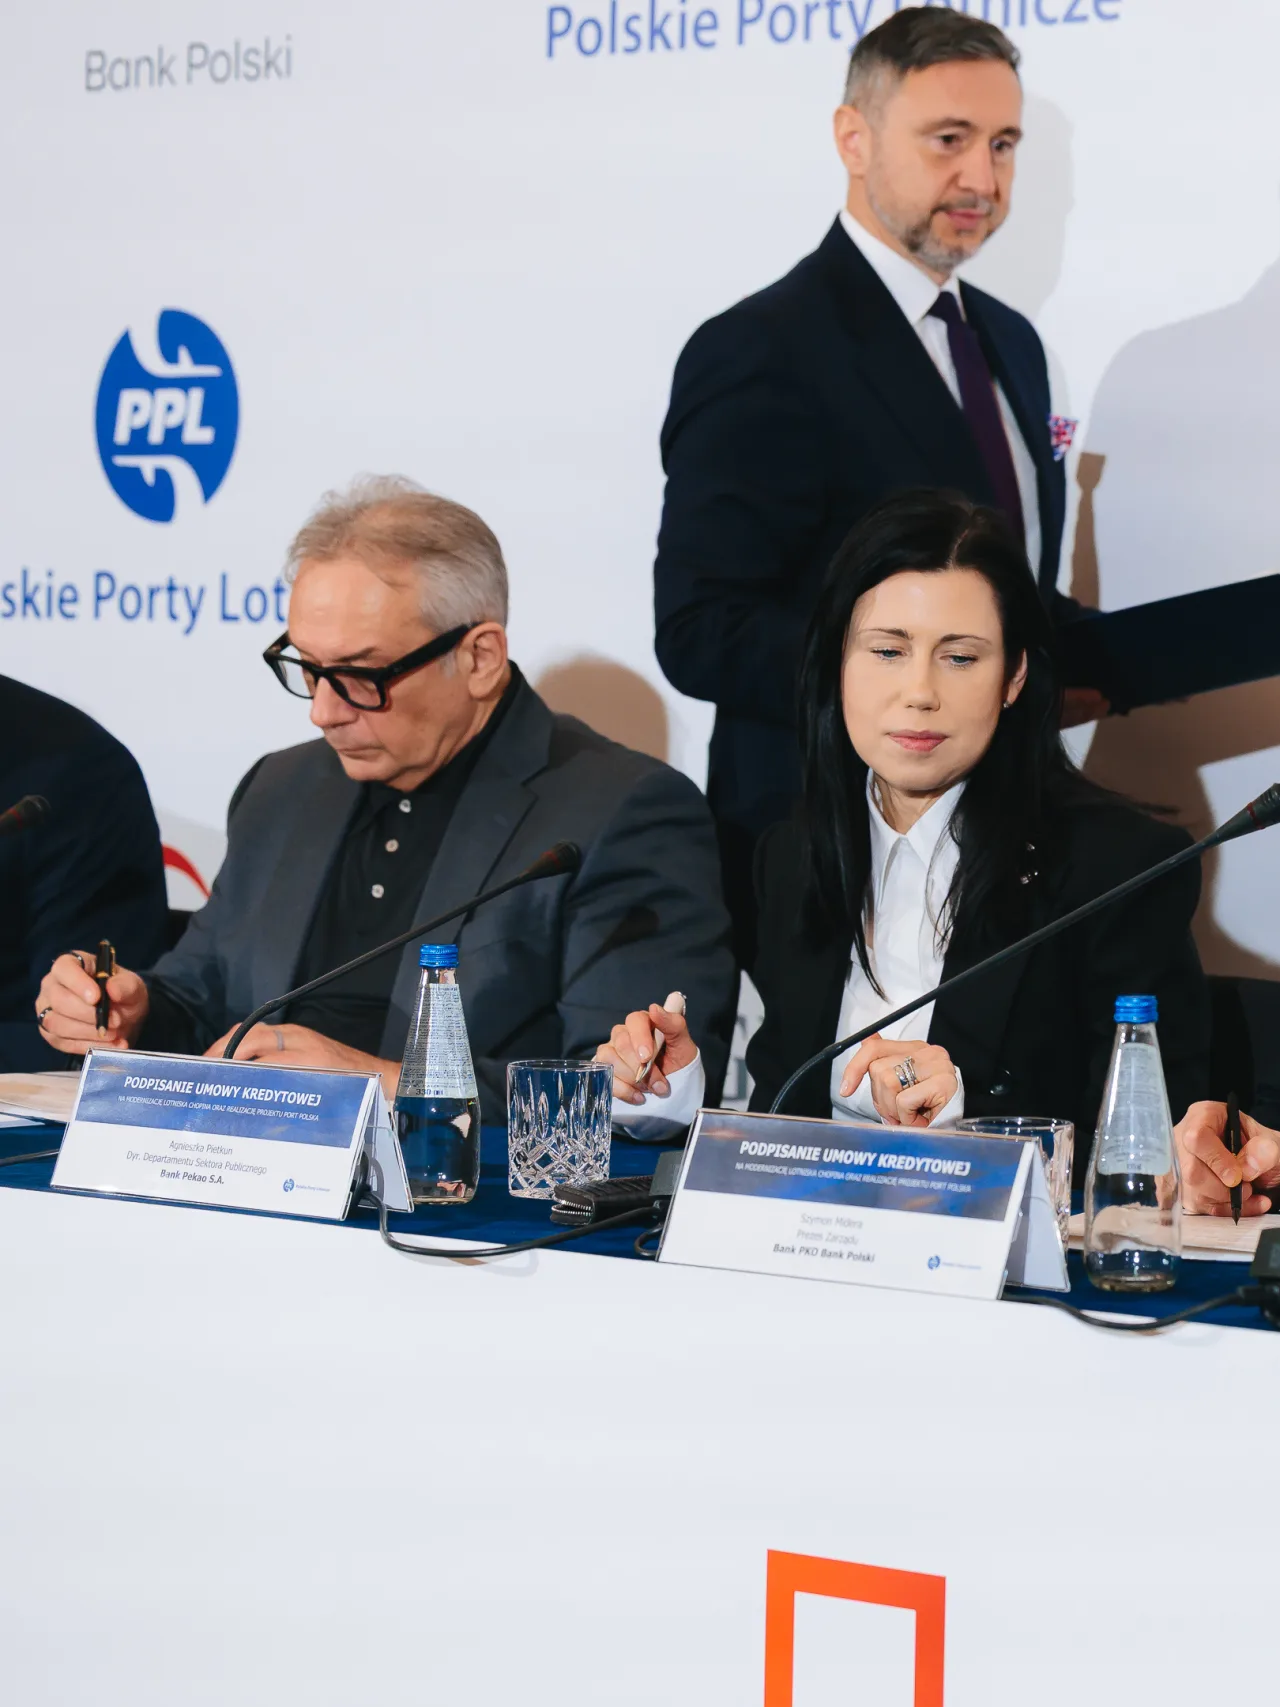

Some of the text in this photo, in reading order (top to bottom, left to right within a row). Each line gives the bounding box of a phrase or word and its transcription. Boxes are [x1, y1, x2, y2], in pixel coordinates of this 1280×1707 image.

[546, 0, 719, 58] Polskie
[738, 0, 874, 52] Porty
[85, 33, 293, 92] Bank Polski
[113, 387, 215, 446] PPL
[93, 569, 206, 637] Porty
[123, 1075, 322, 1107] PODPISANIE UMOWY KREDYTOWEJ
[163, 1099, 188, 1108] LOTNISKA
[188, 1101, 211, 1110] CHOPINA
[211, 1104, 227, 1112] ORAZ
[256, 1108, 283, 1118] PROJEKTU
[283, 1111, 299, 1119] PORT
[298, 1113, 319, 1121] POLSKA
[126, 1150, 268, 1175] Dyr. Departamentu Sektora Publicznego
[169, 1140, 233, 1155] Agnieszka Pietkun
[739, 1140, 971, 1176] PODPISANIE UMOWY KREDYTOWEJ
[160, 1169, 225, 1185] Bank Pekao S.A.
[772, 1243, 876, 1263] Bank PKO Bank Polski
